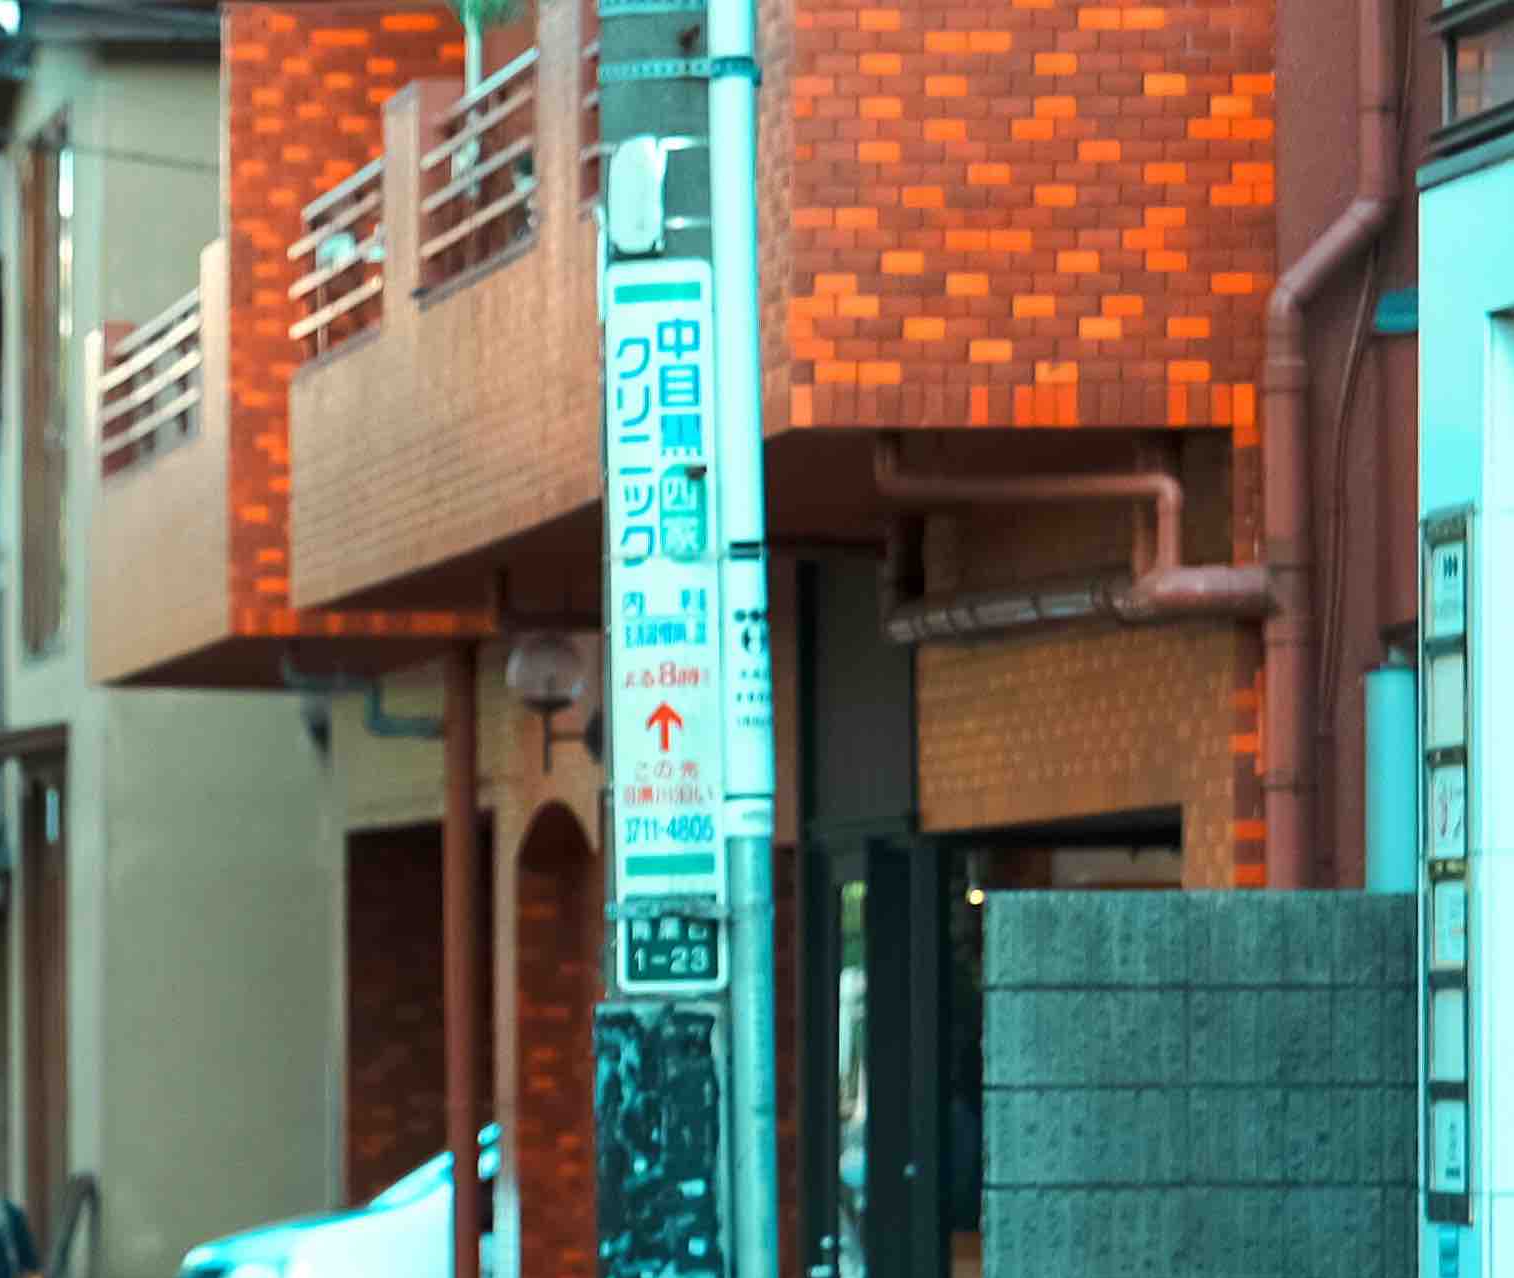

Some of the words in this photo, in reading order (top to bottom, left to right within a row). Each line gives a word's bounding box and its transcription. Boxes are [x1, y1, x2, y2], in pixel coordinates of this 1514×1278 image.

[616, 337, 656, 568] クリニック
[657, 318, 702, 458] 中目黒
